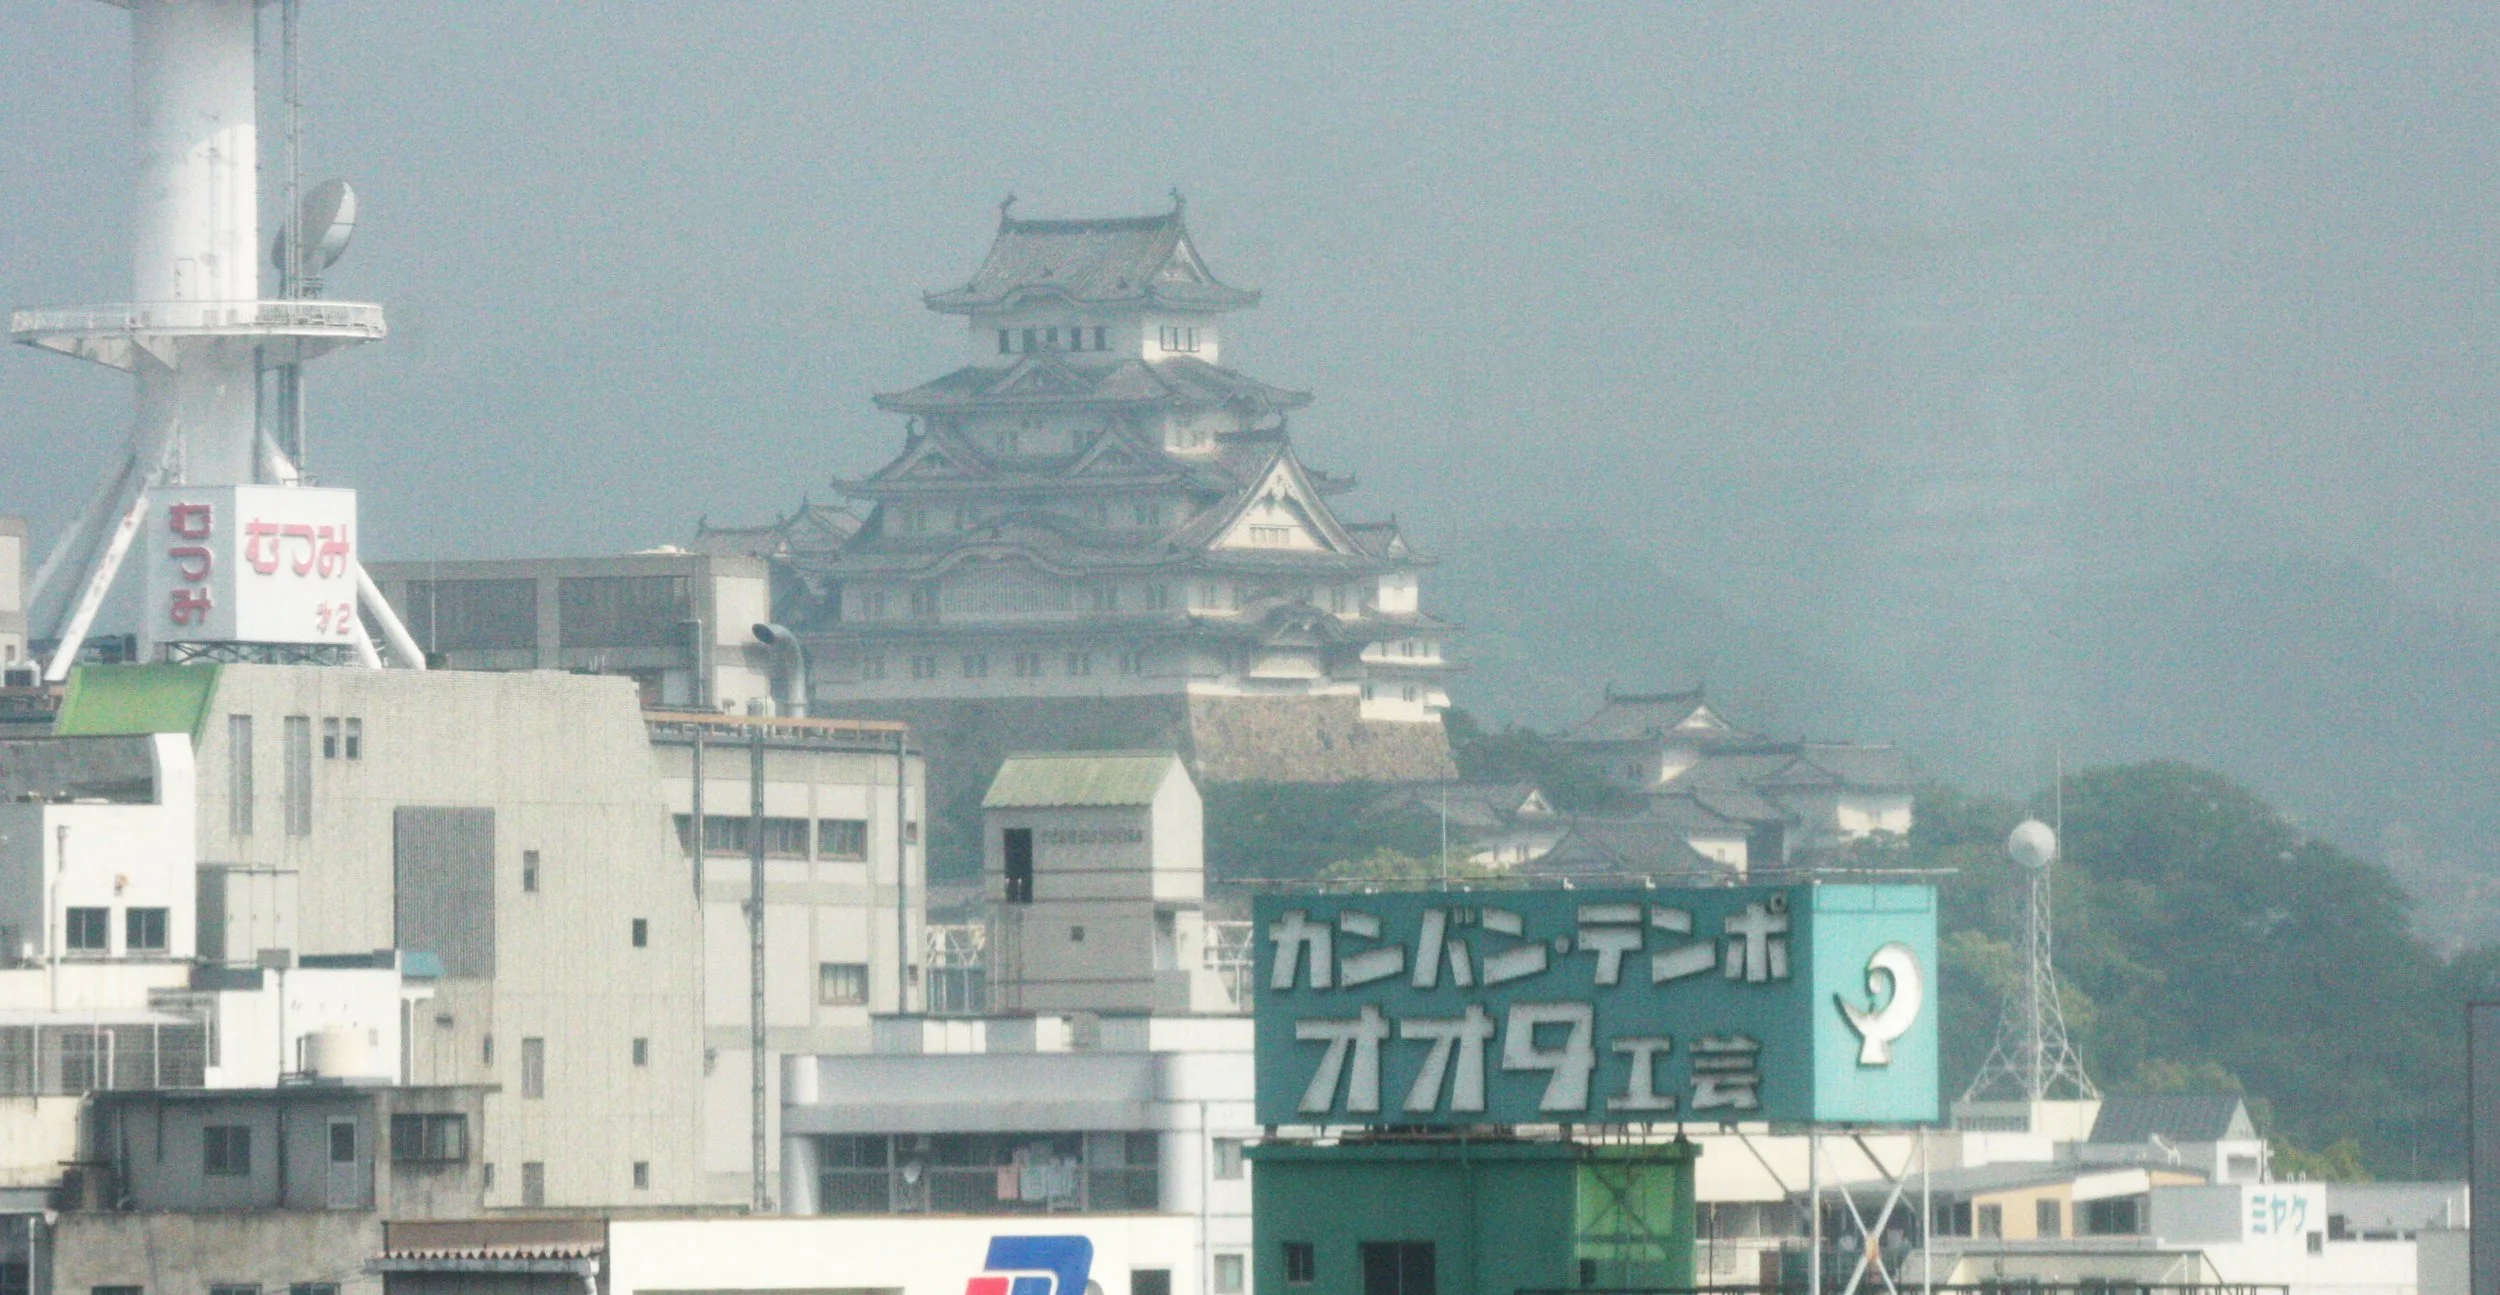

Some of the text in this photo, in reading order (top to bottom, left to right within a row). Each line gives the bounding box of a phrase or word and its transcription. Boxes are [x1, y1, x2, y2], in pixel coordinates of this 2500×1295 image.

[170, 503, 213, 625] むつみ
[245, 518, 350, 578] むつみ
[1269, 895, 1789, 991] カンバン・テンポ
[1296, 1003, 1762, 1113] オオタ工芸
[2252, 1194, 2308, 1234] ミヤケ
